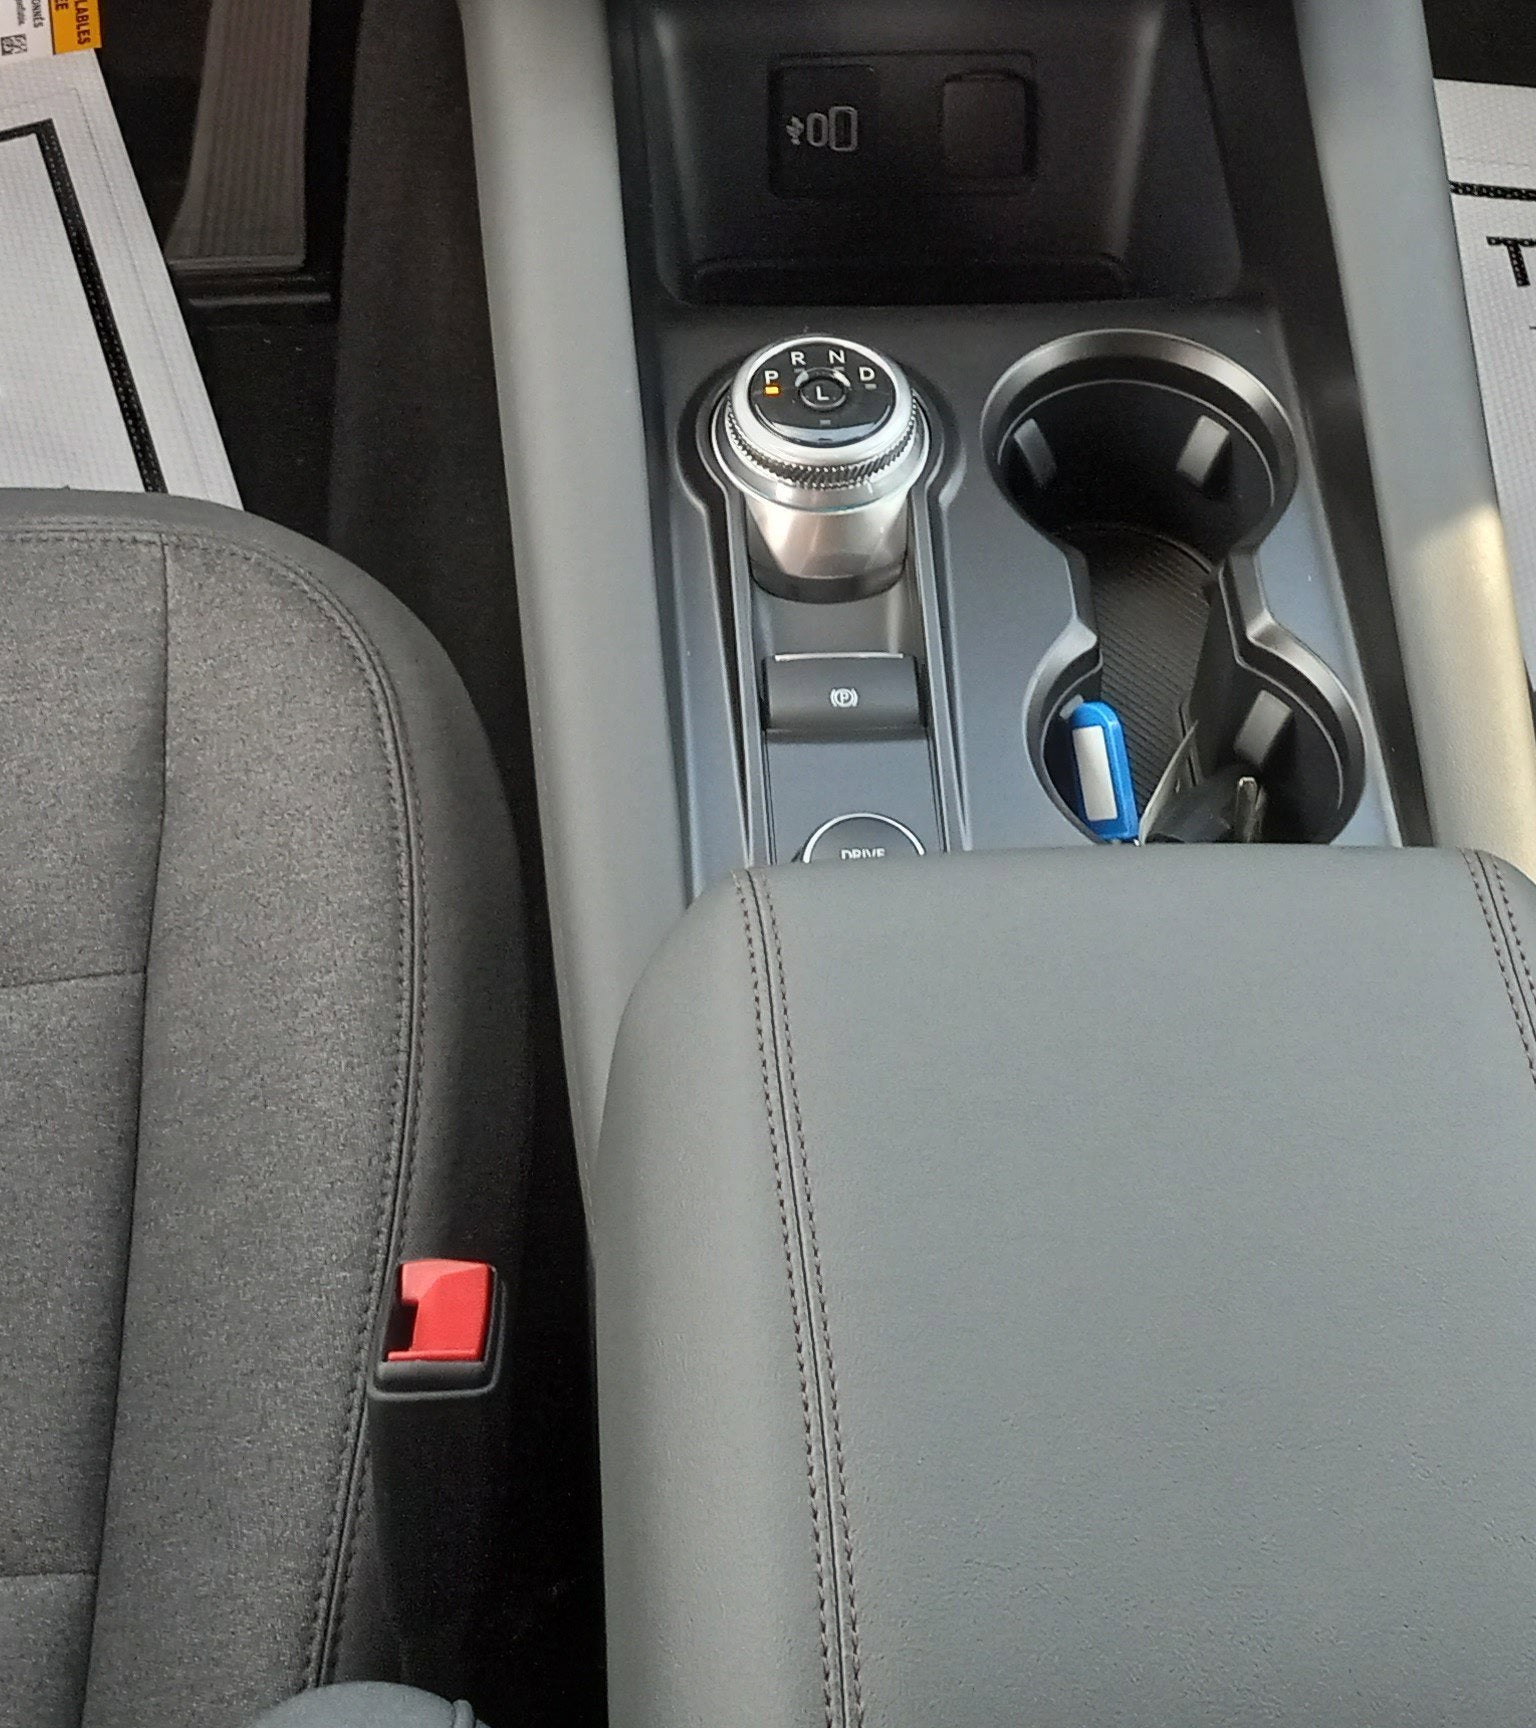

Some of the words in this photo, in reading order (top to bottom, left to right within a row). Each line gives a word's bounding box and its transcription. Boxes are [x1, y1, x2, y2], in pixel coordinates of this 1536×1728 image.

[790, 351, 807, 366] R
[828, 349, 846, 364] N
[764, 370, 779, 385] P
[858, 366, 875, 381] D
[815, 385, 830, 401] L
[841, 847, 885, 860] DRIVE
